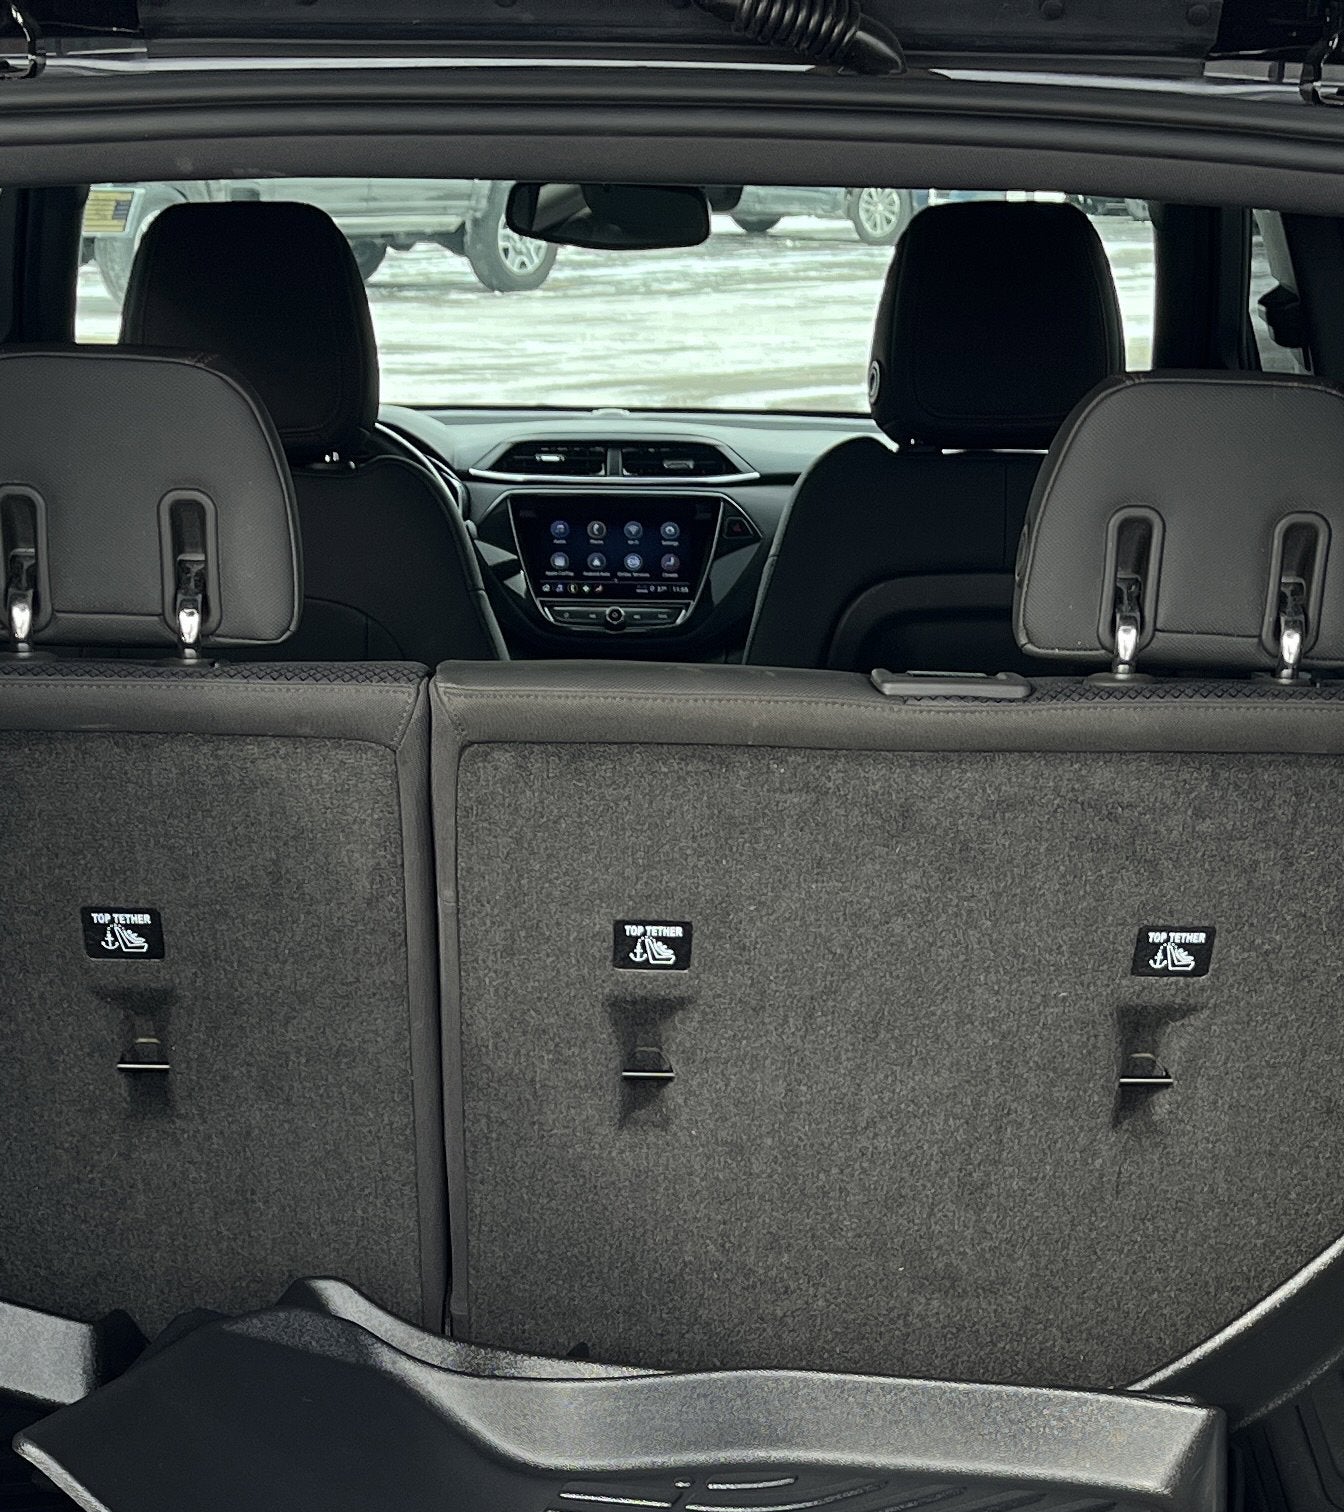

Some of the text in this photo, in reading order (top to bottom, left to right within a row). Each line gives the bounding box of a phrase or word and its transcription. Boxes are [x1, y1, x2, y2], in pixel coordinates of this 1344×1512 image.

[90, 912, 152, 925] TOP TETHER
[624, 924, 683, 938] TOP TETHER
[1147, 931, 1207, 944] TOP TETHER
